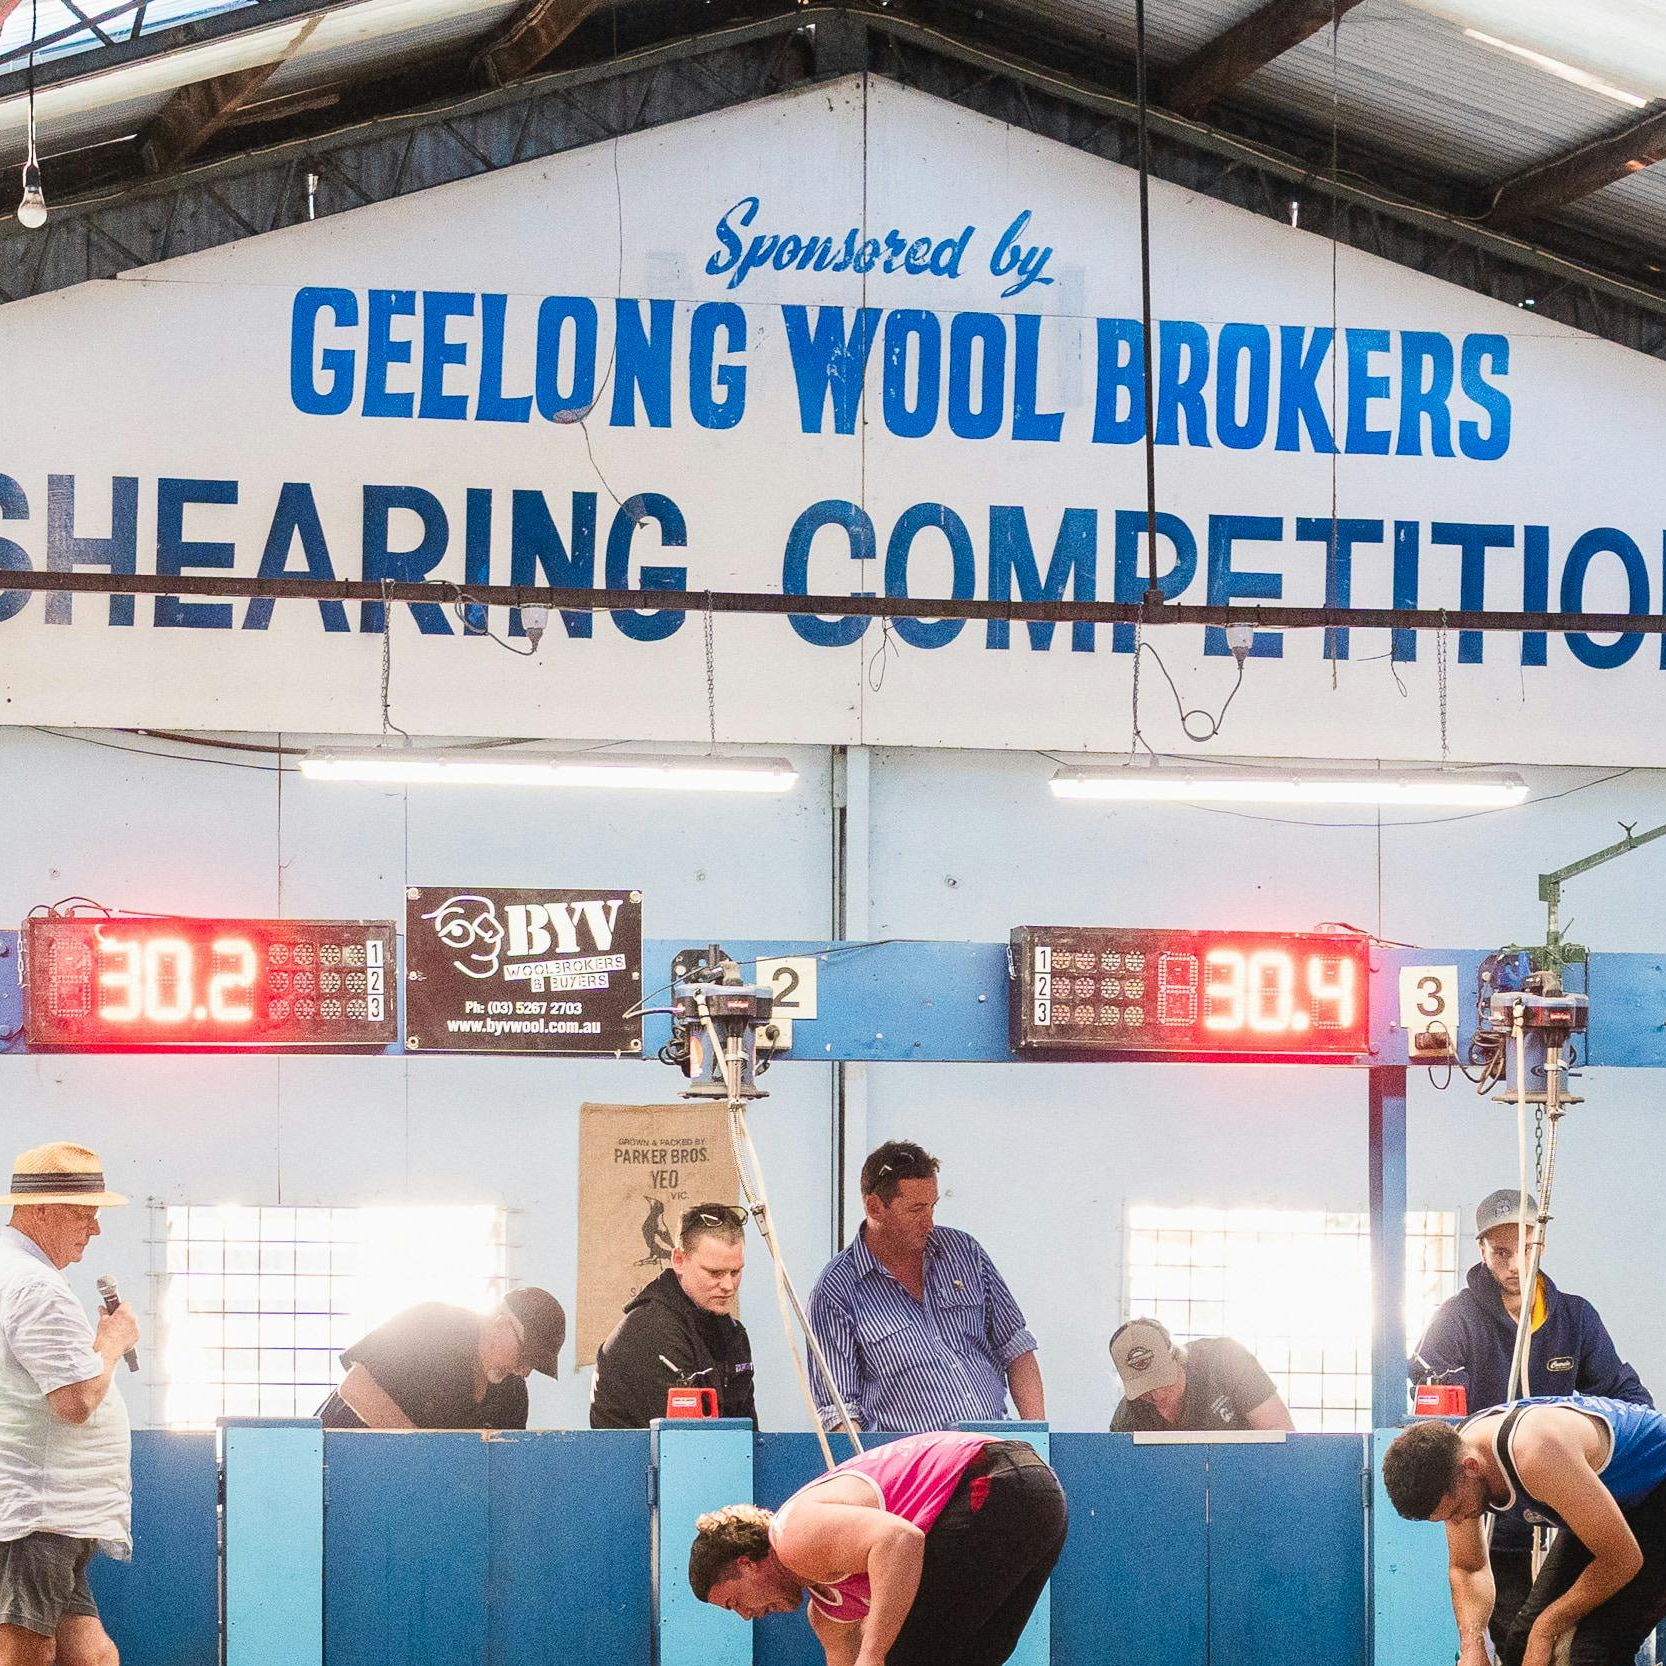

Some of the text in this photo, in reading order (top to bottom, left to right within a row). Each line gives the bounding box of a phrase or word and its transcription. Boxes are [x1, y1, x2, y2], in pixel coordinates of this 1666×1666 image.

[705, 197, 1055, 298] Sponsored by
[290, 284, 1511, 461] GEELONG WOOL BROKERS
[504, 900, 623, 956] BYV
[371, 944, 379, 959] 1
[1040, 951, 1047, 969] 1
[505, 956, 624, 979] WOOLBROKERS
[97, 939, 258, 1022] 30.2
[371, 975, 380, 991] 2
[552, 974, 609, 990] BUYERS
[772, 967, 800, 1008] 2
[1039, 976, 1047, 996] 2
[1203, 949, 1357, 1032] 30.4
[1416, 976, 1445, 1016] 3
[371, 1002, 380, 1018] 3
[465, 1001, 583, 1016] Ph: (03) 5267 2703
[1039, 1002, 1047, 1022] 3
[446, 1018, 601, 1037] www.byvwool.com.au
[618, 1138, 648, 1146] GROWN
[660, 1138, 693, 1146] PACKED
[694, 1138, 706, 1146] BY
[614, 1147, 710, 1165] PARKER BROS.
[651, 1170, 679, 1190] YEO
